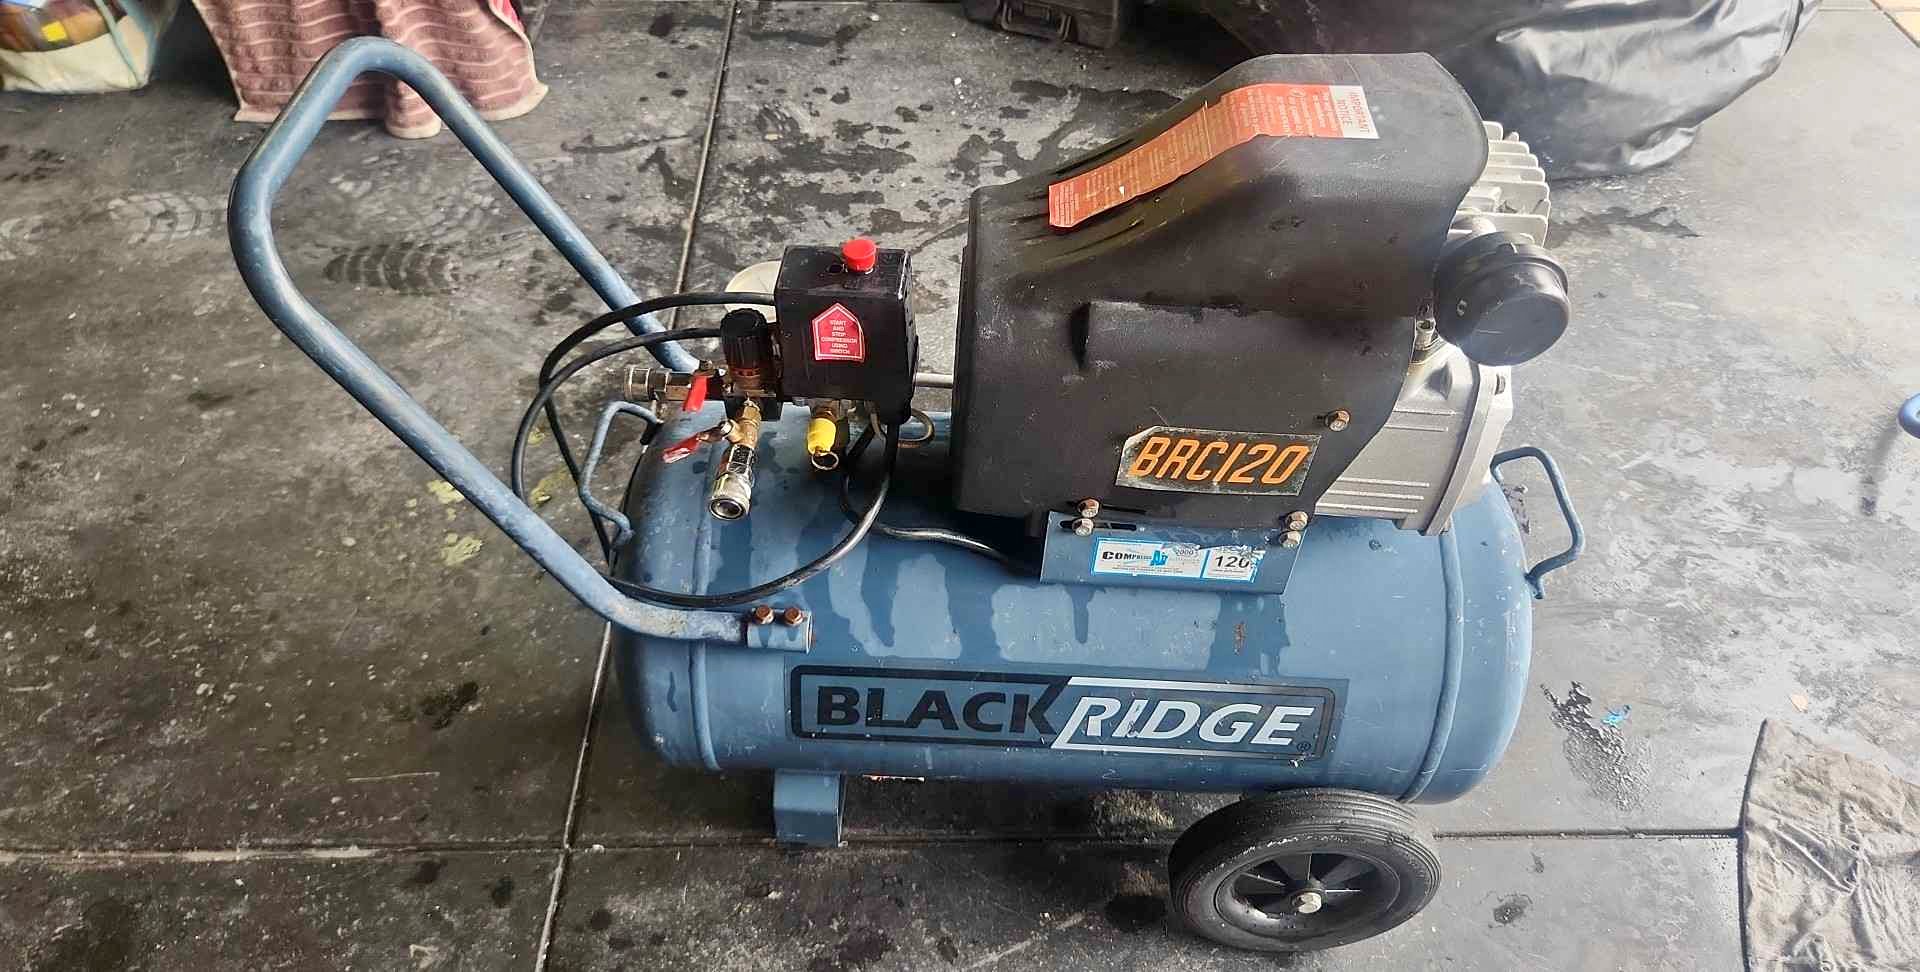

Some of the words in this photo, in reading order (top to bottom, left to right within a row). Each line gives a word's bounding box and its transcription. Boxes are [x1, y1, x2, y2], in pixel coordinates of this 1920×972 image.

[1336, 99, 1354, 126] NOTICE
[1349, 92, 1370, 134] IMPORTANT
[1127, 436, 1310, 485] BRC120
[1214, 555, 1250, 568] 120
